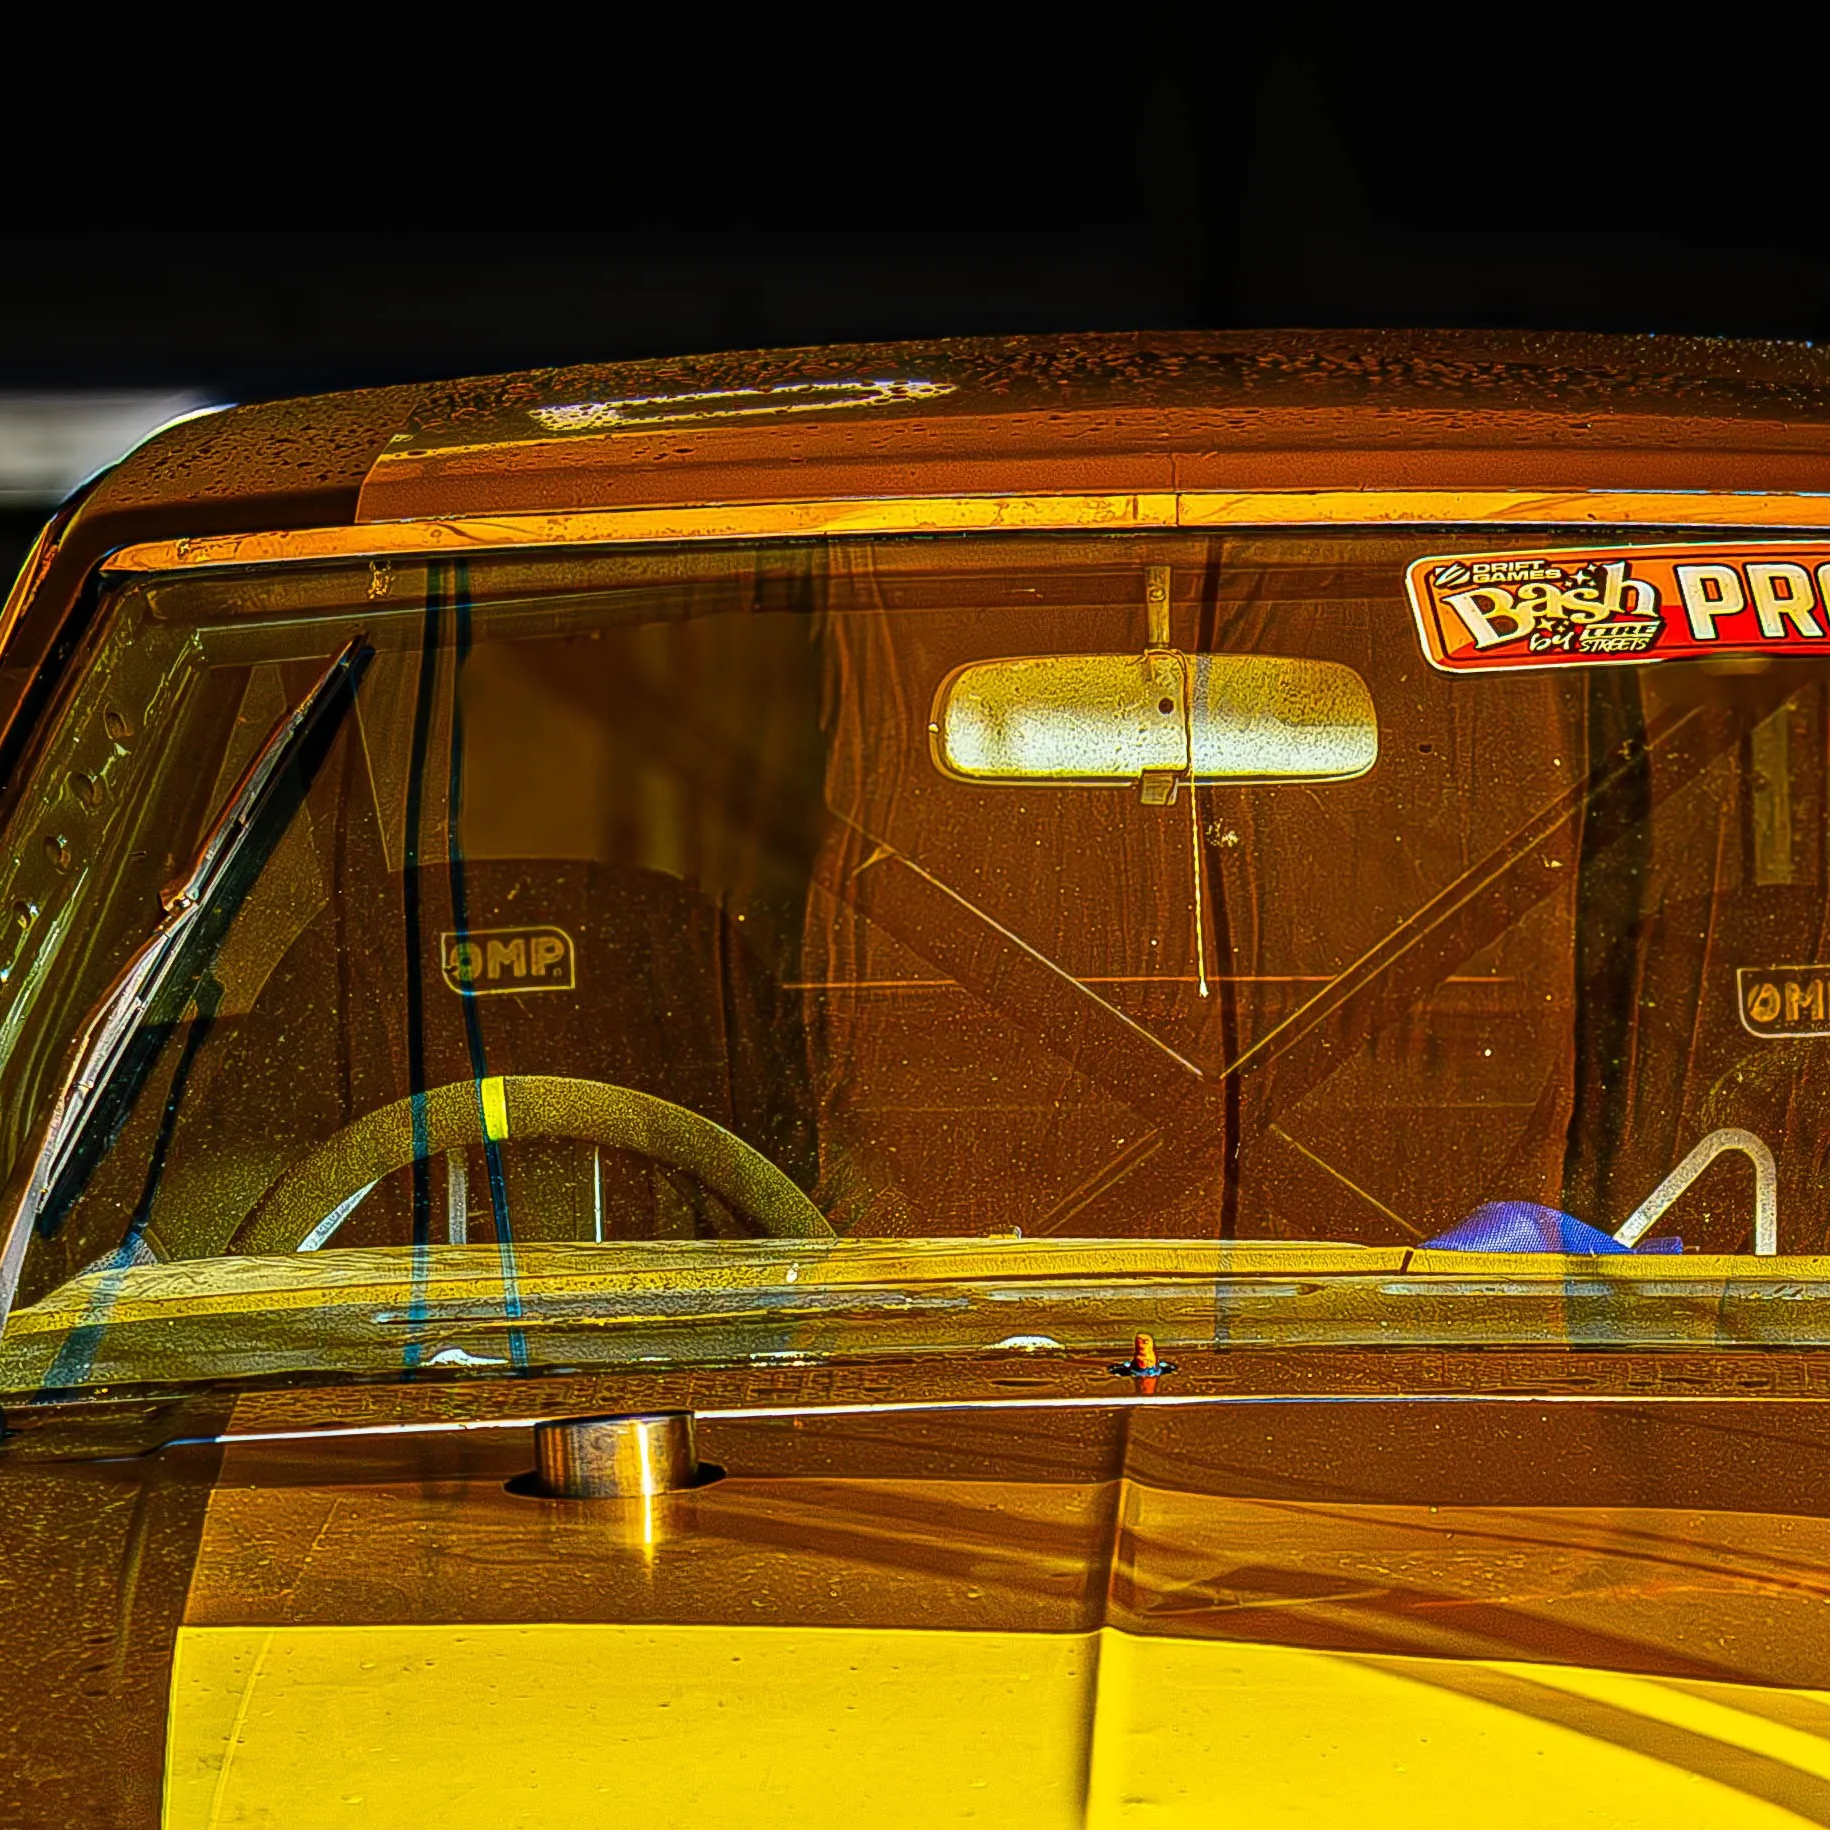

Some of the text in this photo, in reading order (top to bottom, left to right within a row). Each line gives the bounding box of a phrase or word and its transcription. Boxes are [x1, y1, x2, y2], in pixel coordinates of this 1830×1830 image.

[1472, 560, 1545, 573] DRIFT
[1472, 568, 1562, 583] GAMES
[1442, 560, 1660, 649] Bash
[1530, 631, 1574, 651] by
[1579, 637, 1650, 653] STREETS
[450, 936, 565, 979] OMP
